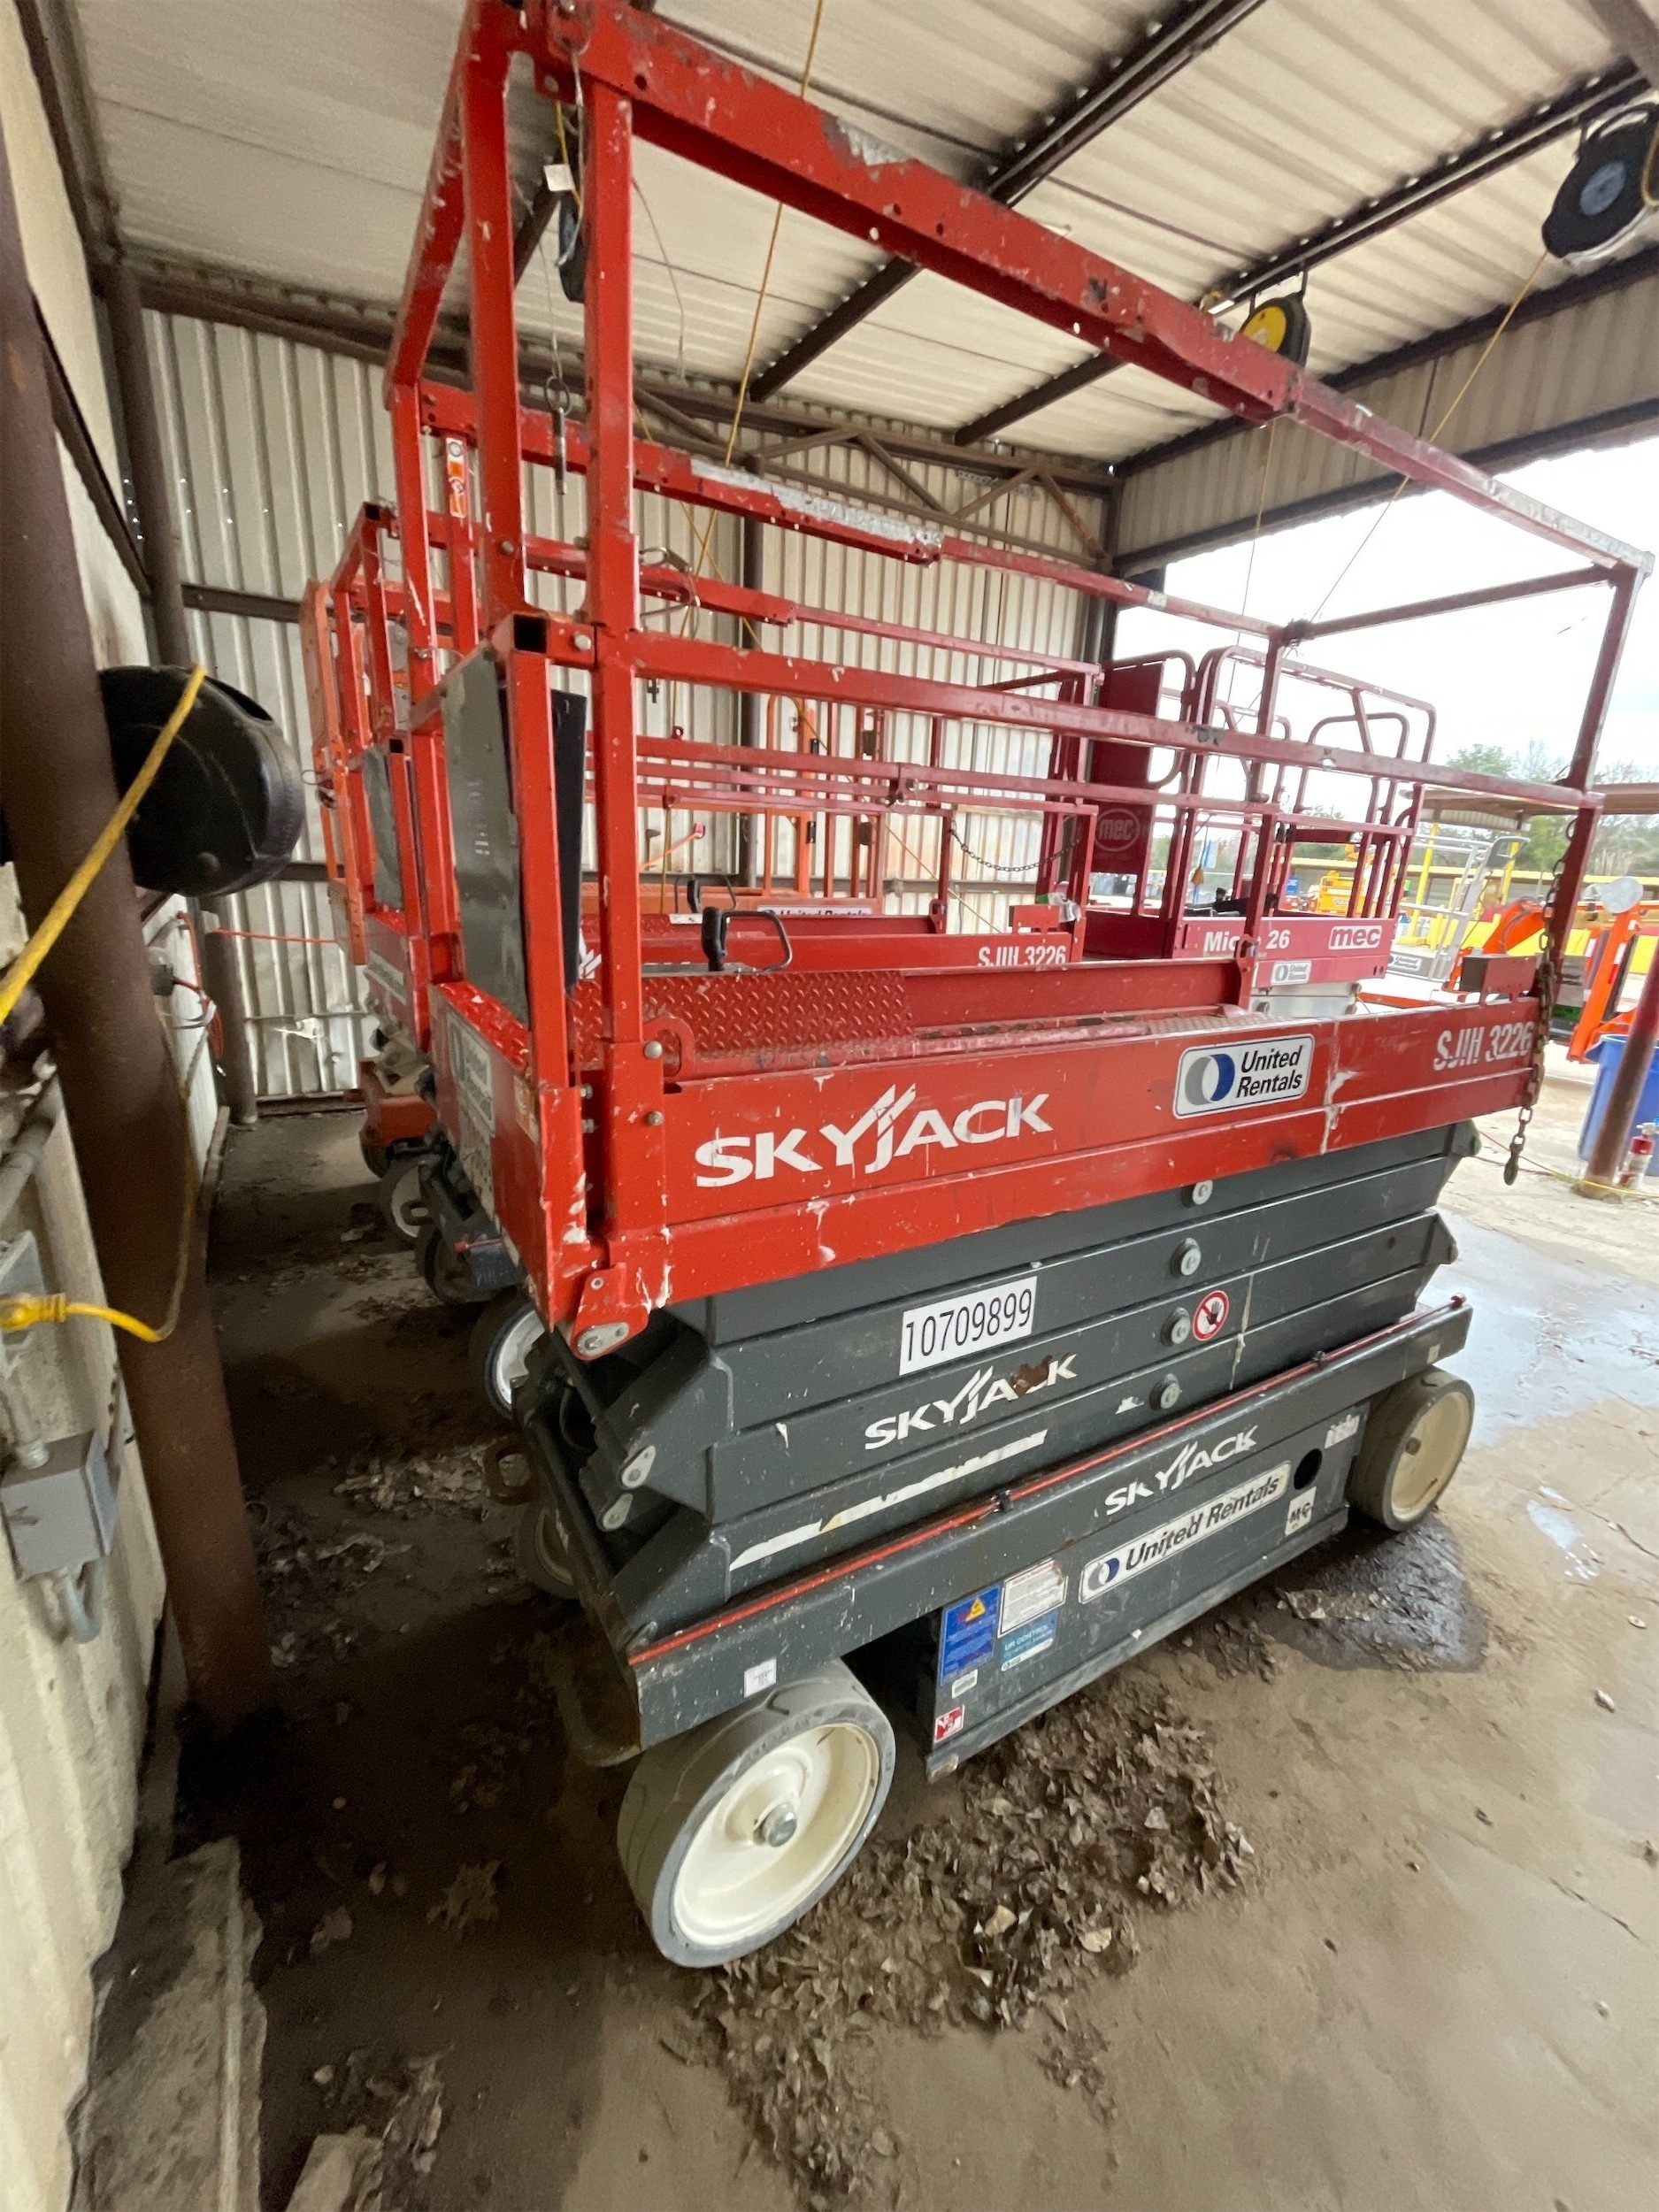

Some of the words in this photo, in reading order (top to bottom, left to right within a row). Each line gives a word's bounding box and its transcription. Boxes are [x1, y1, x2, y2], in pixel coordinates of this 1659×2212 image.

[1098, 819, 1133, 841] mec
[1266, 930, 1291, 949] 26
[1331, 927, 1381, 948] mec
[1024, 945, 1067, 966] 3226
[1241, 1045, 1304, 1073] United
[1486, 1021, 1535, 1062] 3226
[1236, 1069, 1302, 1098] Rentals
[695, 1082, 1054, 1187] SKYJACK
[906, 1288, 1032, 1362] 10709899
[864, 1353, 1078, 1450] SKYJAK
[1105, 1425, 1258, 1516] SKYJACK
[1125, 1512, 1203, 1571] United
[1206, 1477, 1279, 1529] Rentals
